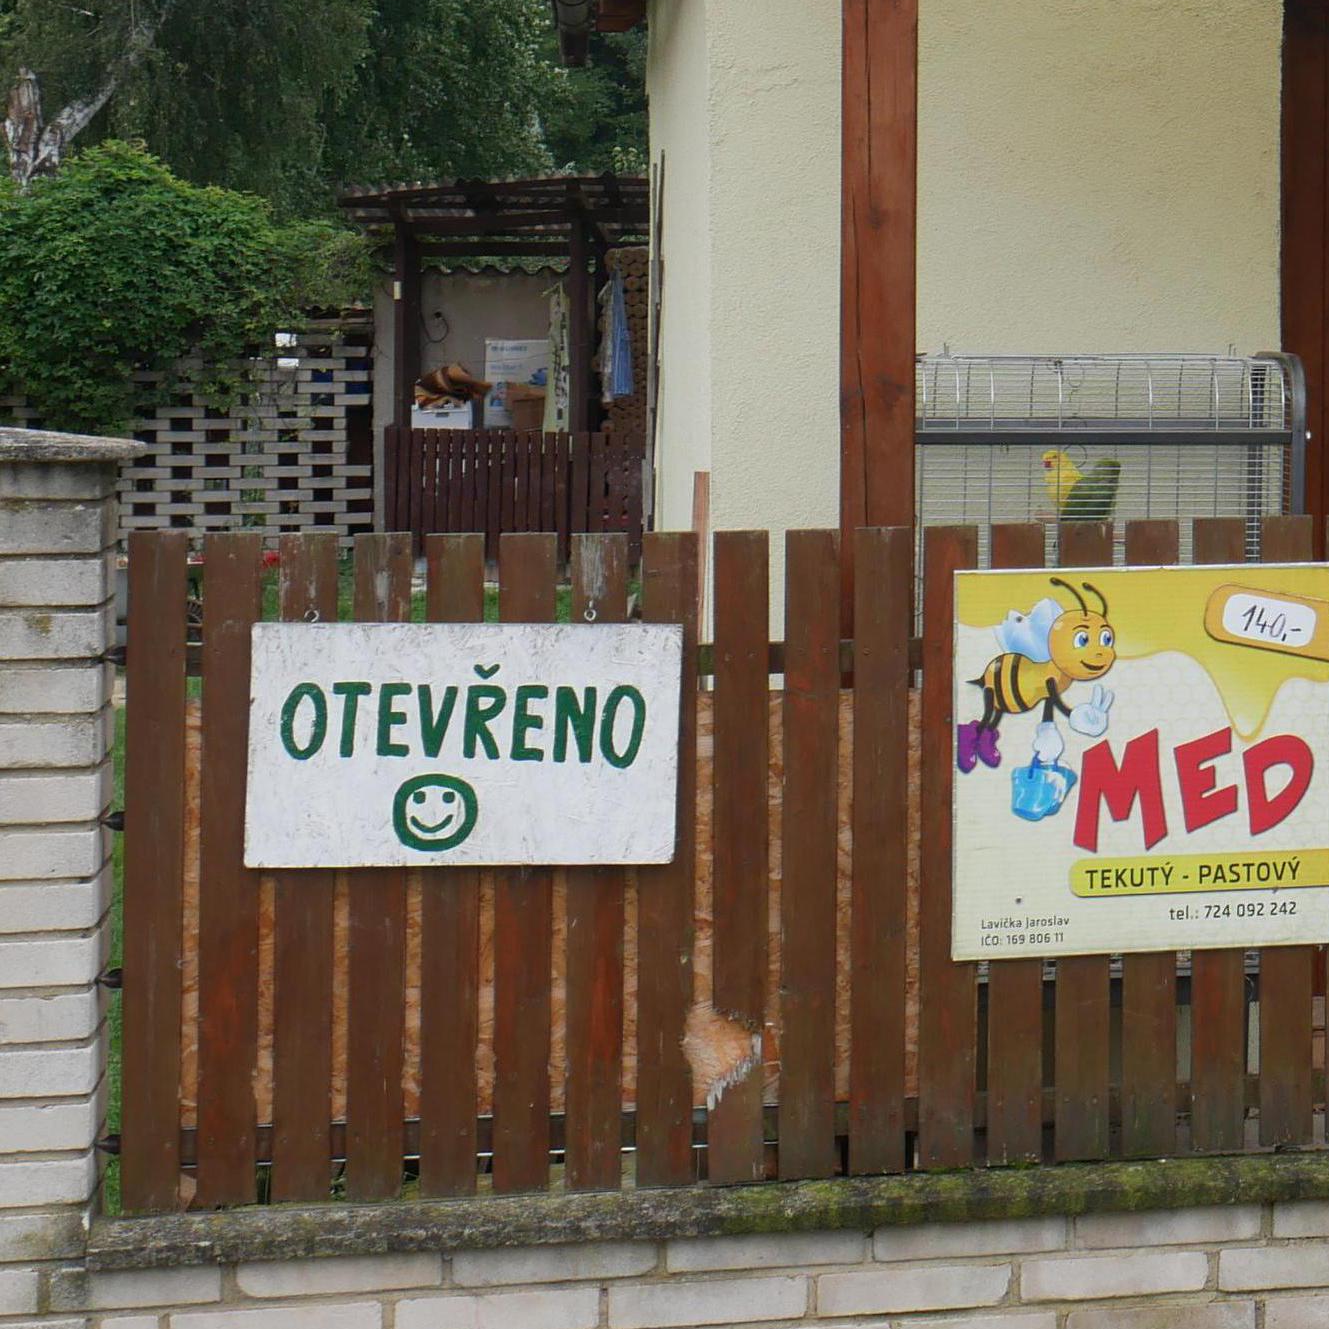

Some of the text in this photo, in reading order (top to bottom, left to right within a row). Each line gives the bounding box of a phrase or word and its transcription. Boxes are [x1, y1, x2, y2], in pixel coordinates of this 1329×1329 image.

[280, 663, 647, 769] OTEVŘENO
[1073, 726, 1315, 853] MED
[1085, 861, 1175, 890] TEKUTÝ
[1198, 856, 1301, 885] PASTOVÝ
[981, 915, 1070, 929] Lavička Jaroslav
[1204, 904, 1231, 919] 724
[1236, 902, 1265, 917] 092
[1270, 901, 1297, 915] 242
[1006, 934, 1025, 945] 169
[1029, 932, 1050, 944] 806
